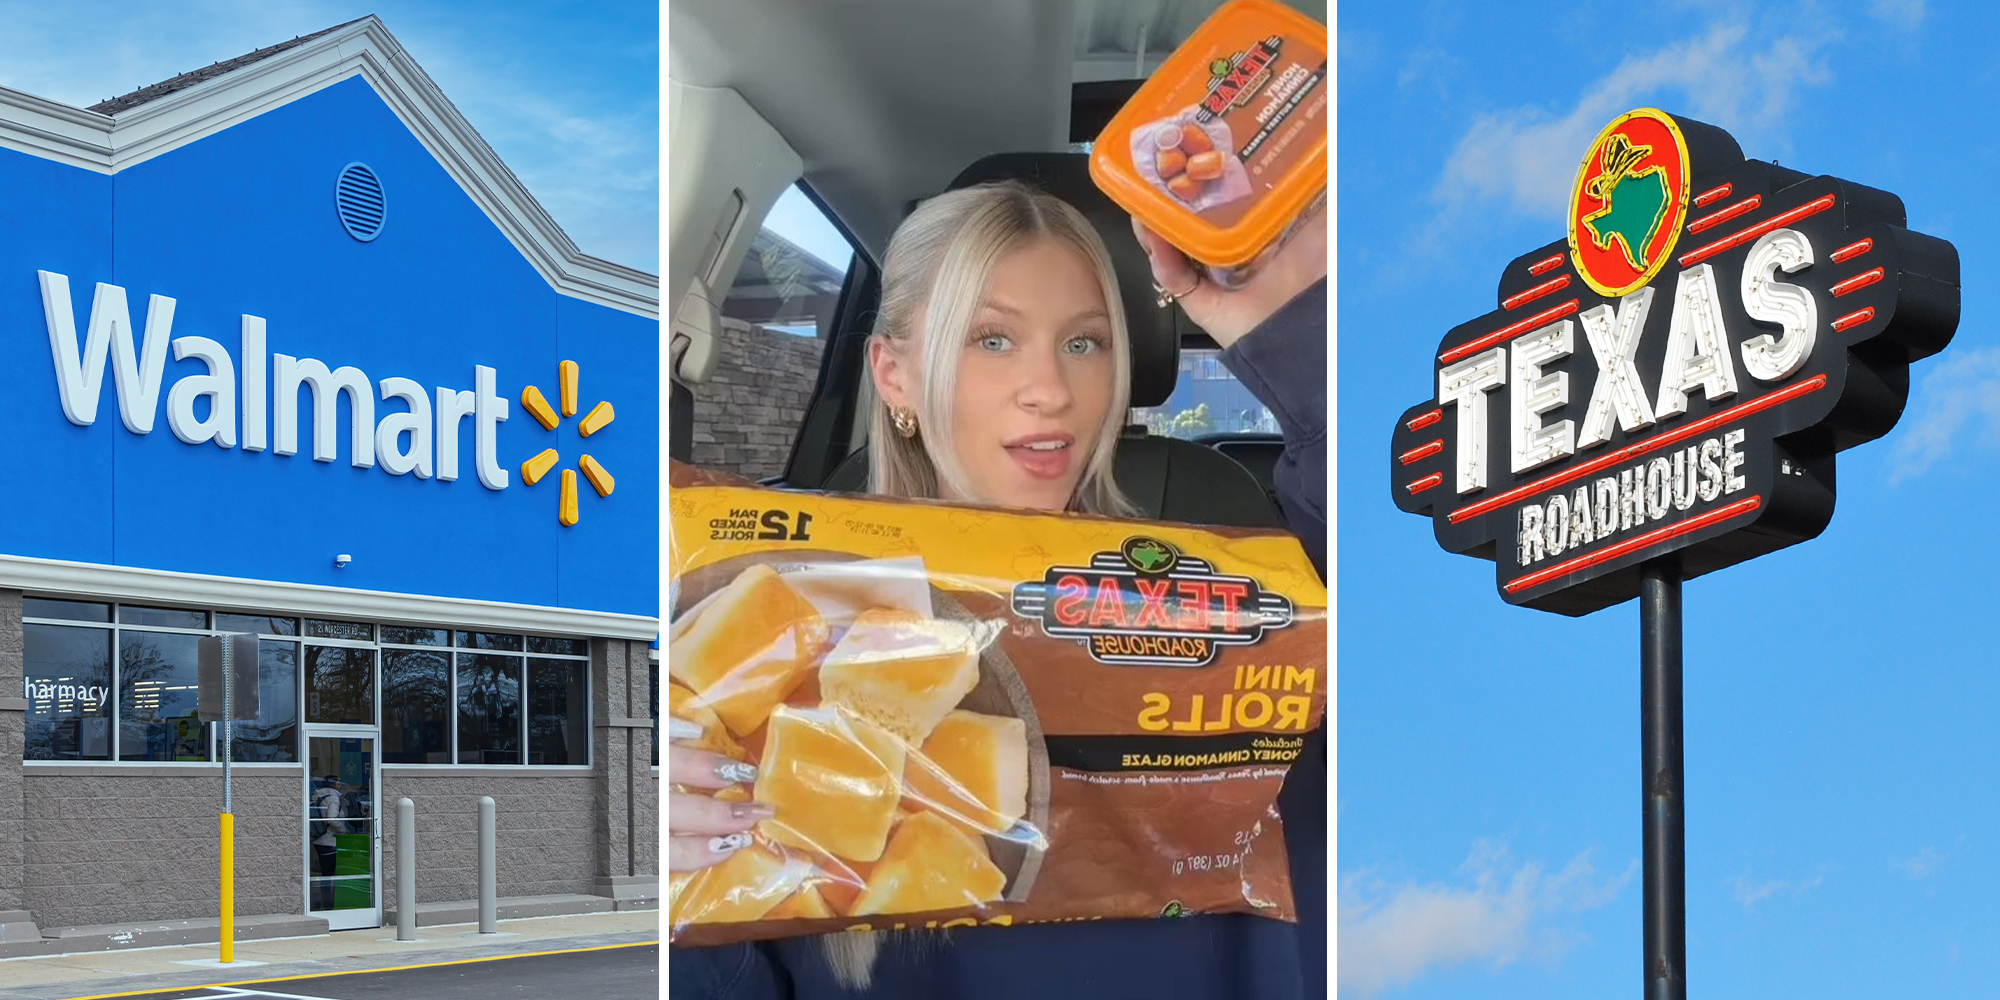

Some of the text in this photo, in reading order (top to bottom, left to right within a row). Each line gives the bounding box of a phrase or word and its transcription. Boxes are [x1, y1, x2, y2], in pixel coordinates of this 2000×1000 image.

[37, 269, 509, 491] Walmart
[1438, 228, 1818, 495] TEXAS
[1517, 429, 1747, 567] ROADHOUSE
[24, 676, 109, 707] harmacy
